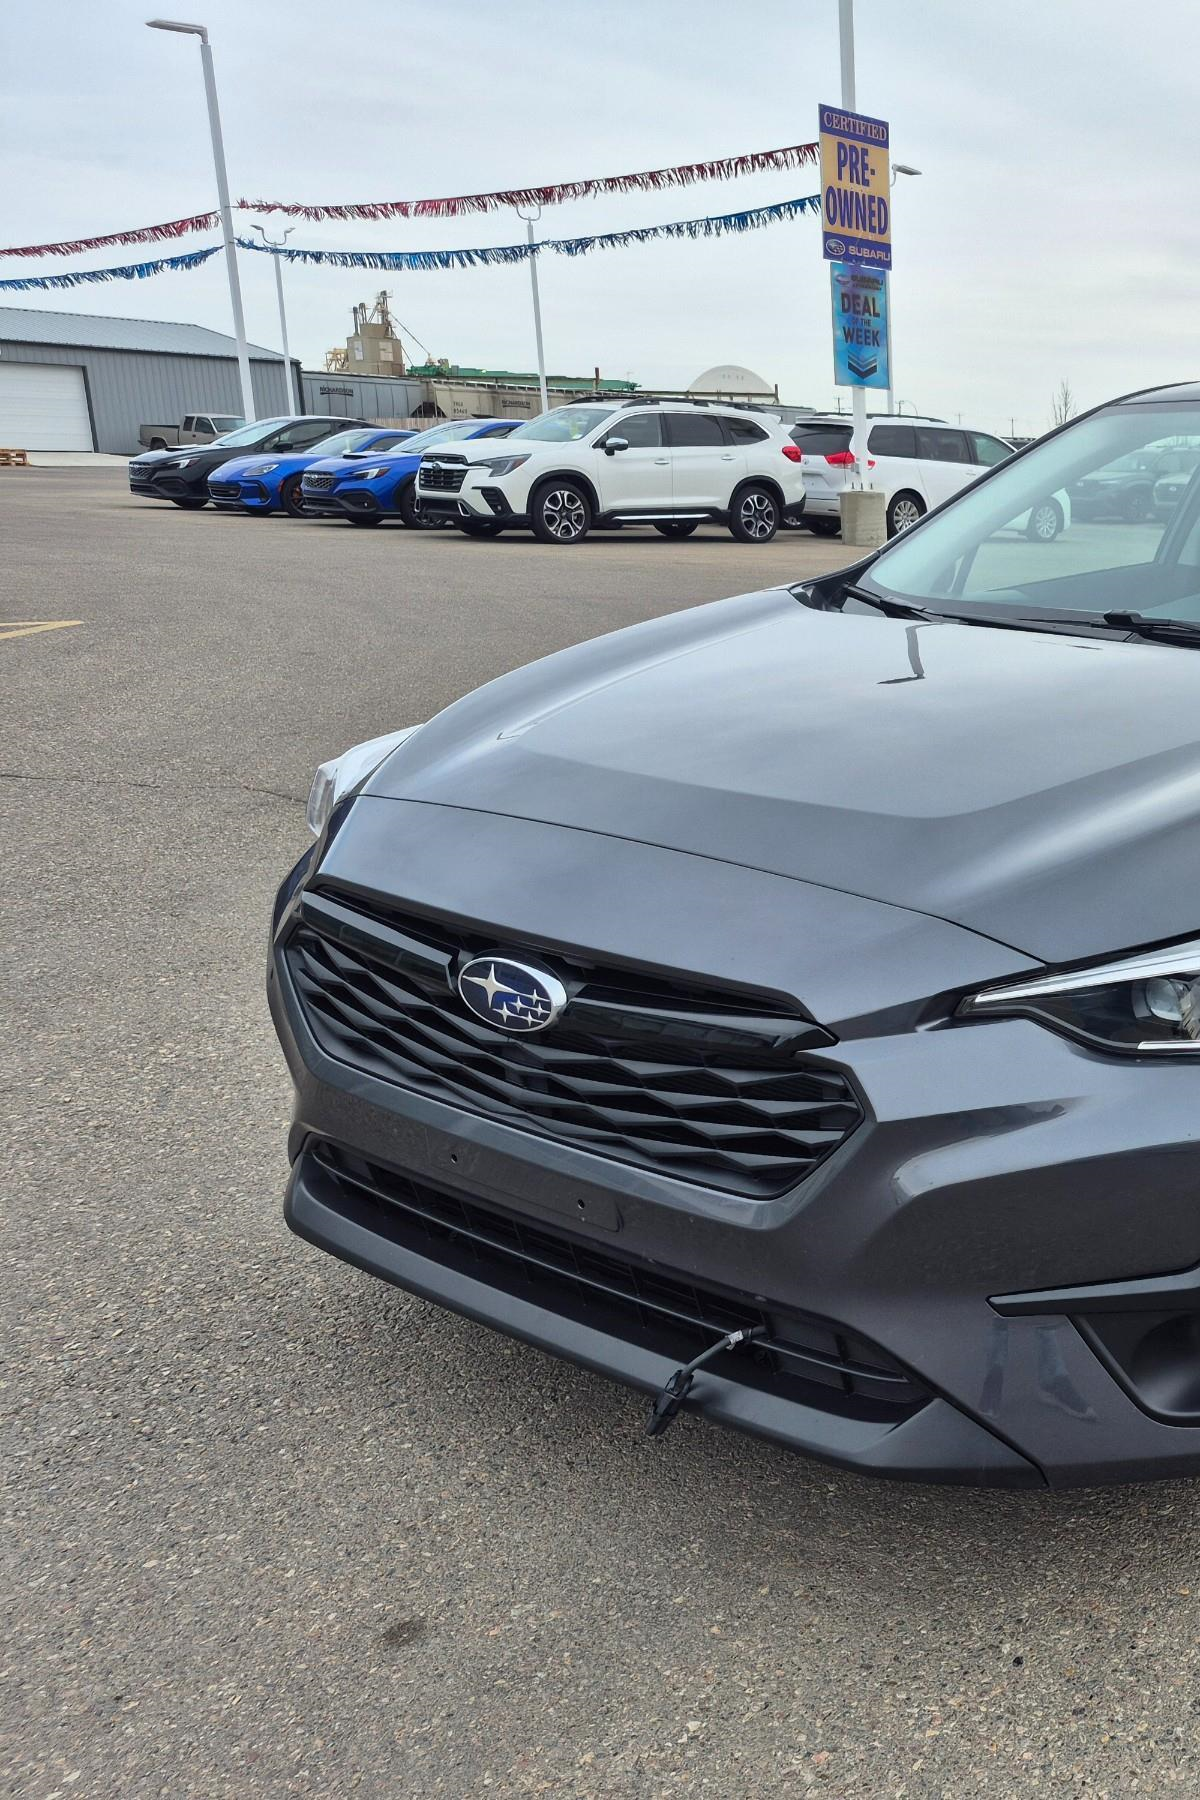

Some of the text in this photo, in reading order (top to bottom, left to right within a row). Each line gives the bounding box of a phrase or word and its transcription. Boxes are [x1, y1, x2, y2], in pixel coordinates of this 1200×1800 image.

[824, 112, 887, 141] CERTIFIED
[837, 142, 875, 187] PRE-
[826, 186, 888, 235] OWNED
[848, 245, 890, 261] SUBARU
[841, 293, 880, 317] DEAL
[861, 318, 871, 327] THE
[843, 326, 880, 348] WEEK
